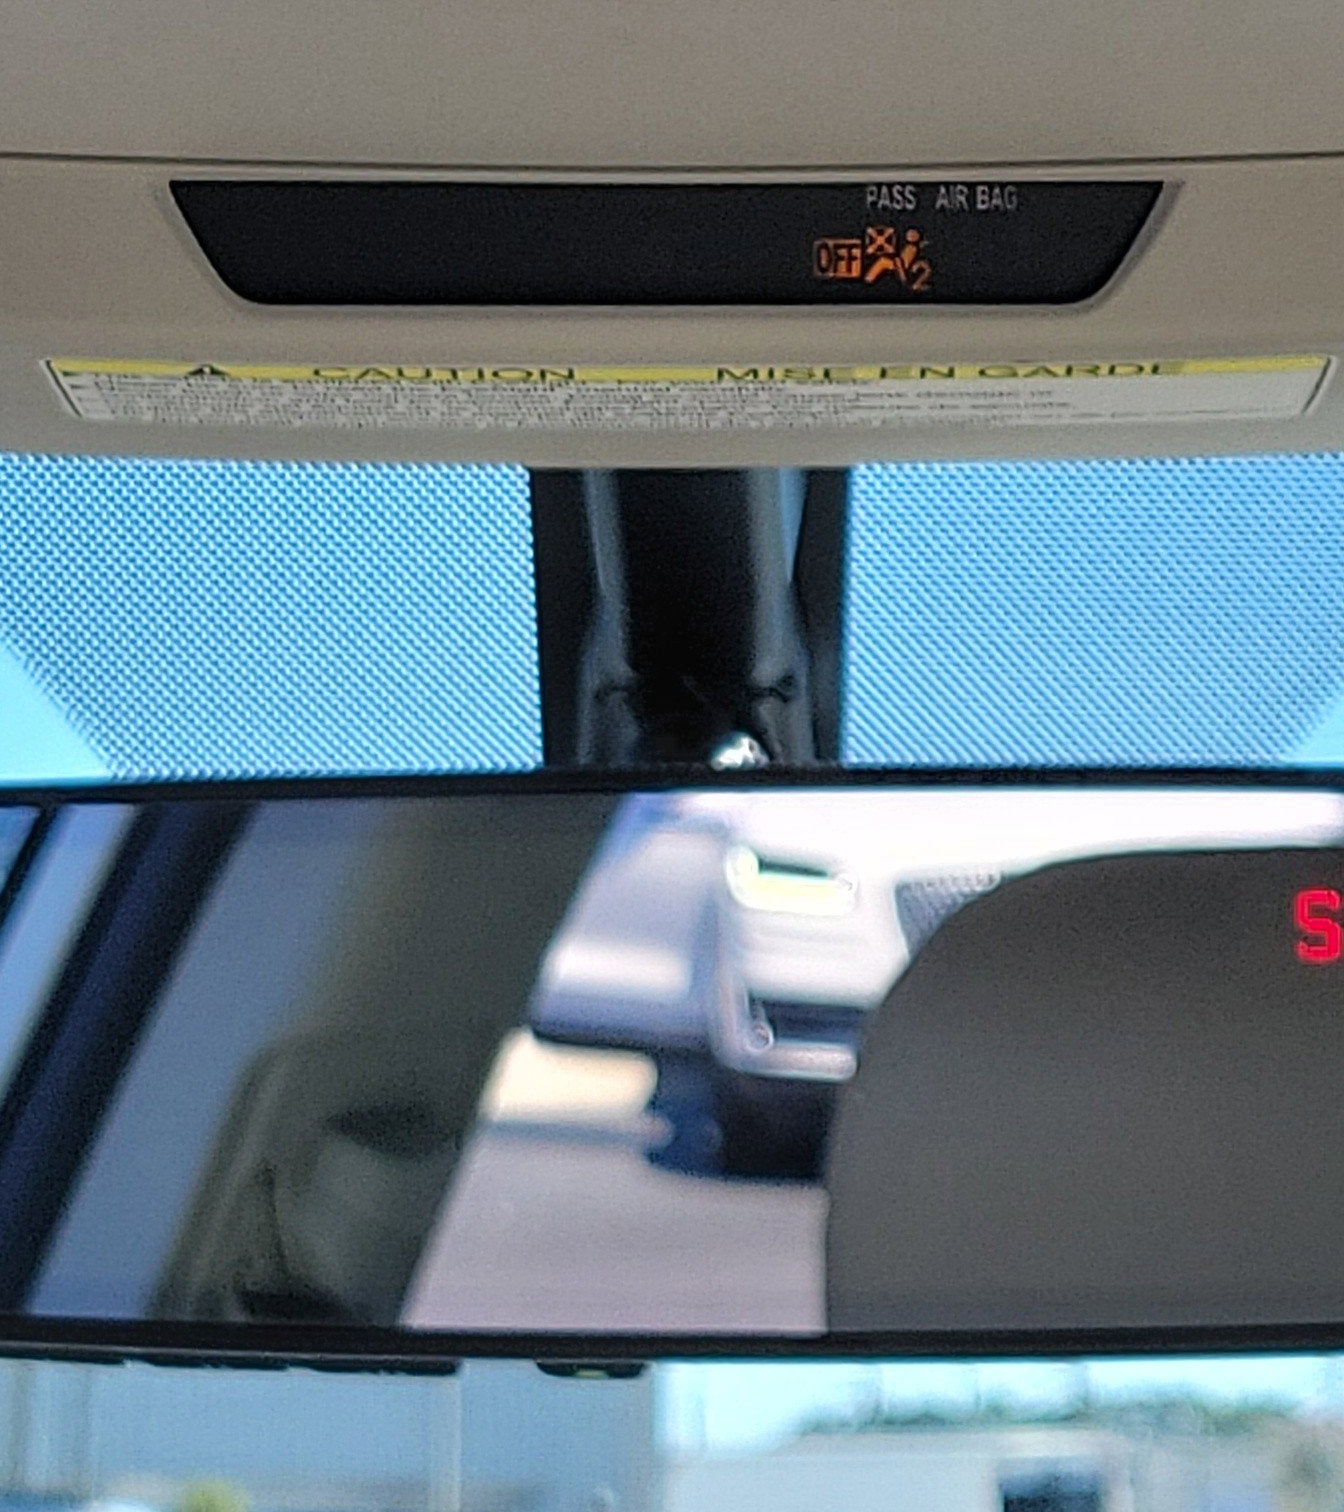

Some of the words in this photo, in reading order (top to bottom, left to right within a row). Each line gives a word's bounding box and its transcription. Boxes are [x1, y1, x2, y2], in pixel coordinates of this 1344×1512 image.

[865, 185, 917, 210] PASS
[934, 185, 968, 210] AIR
[976, 186, 1018, 210] BAG
[816, 242, 861, 274] OFF
[313, 367, 575, 380] CAUTION
[716, 367, 854, 380] MISE
[879, 366, 956, 378] EN
[977, 363, 1186, 378] GARDE
